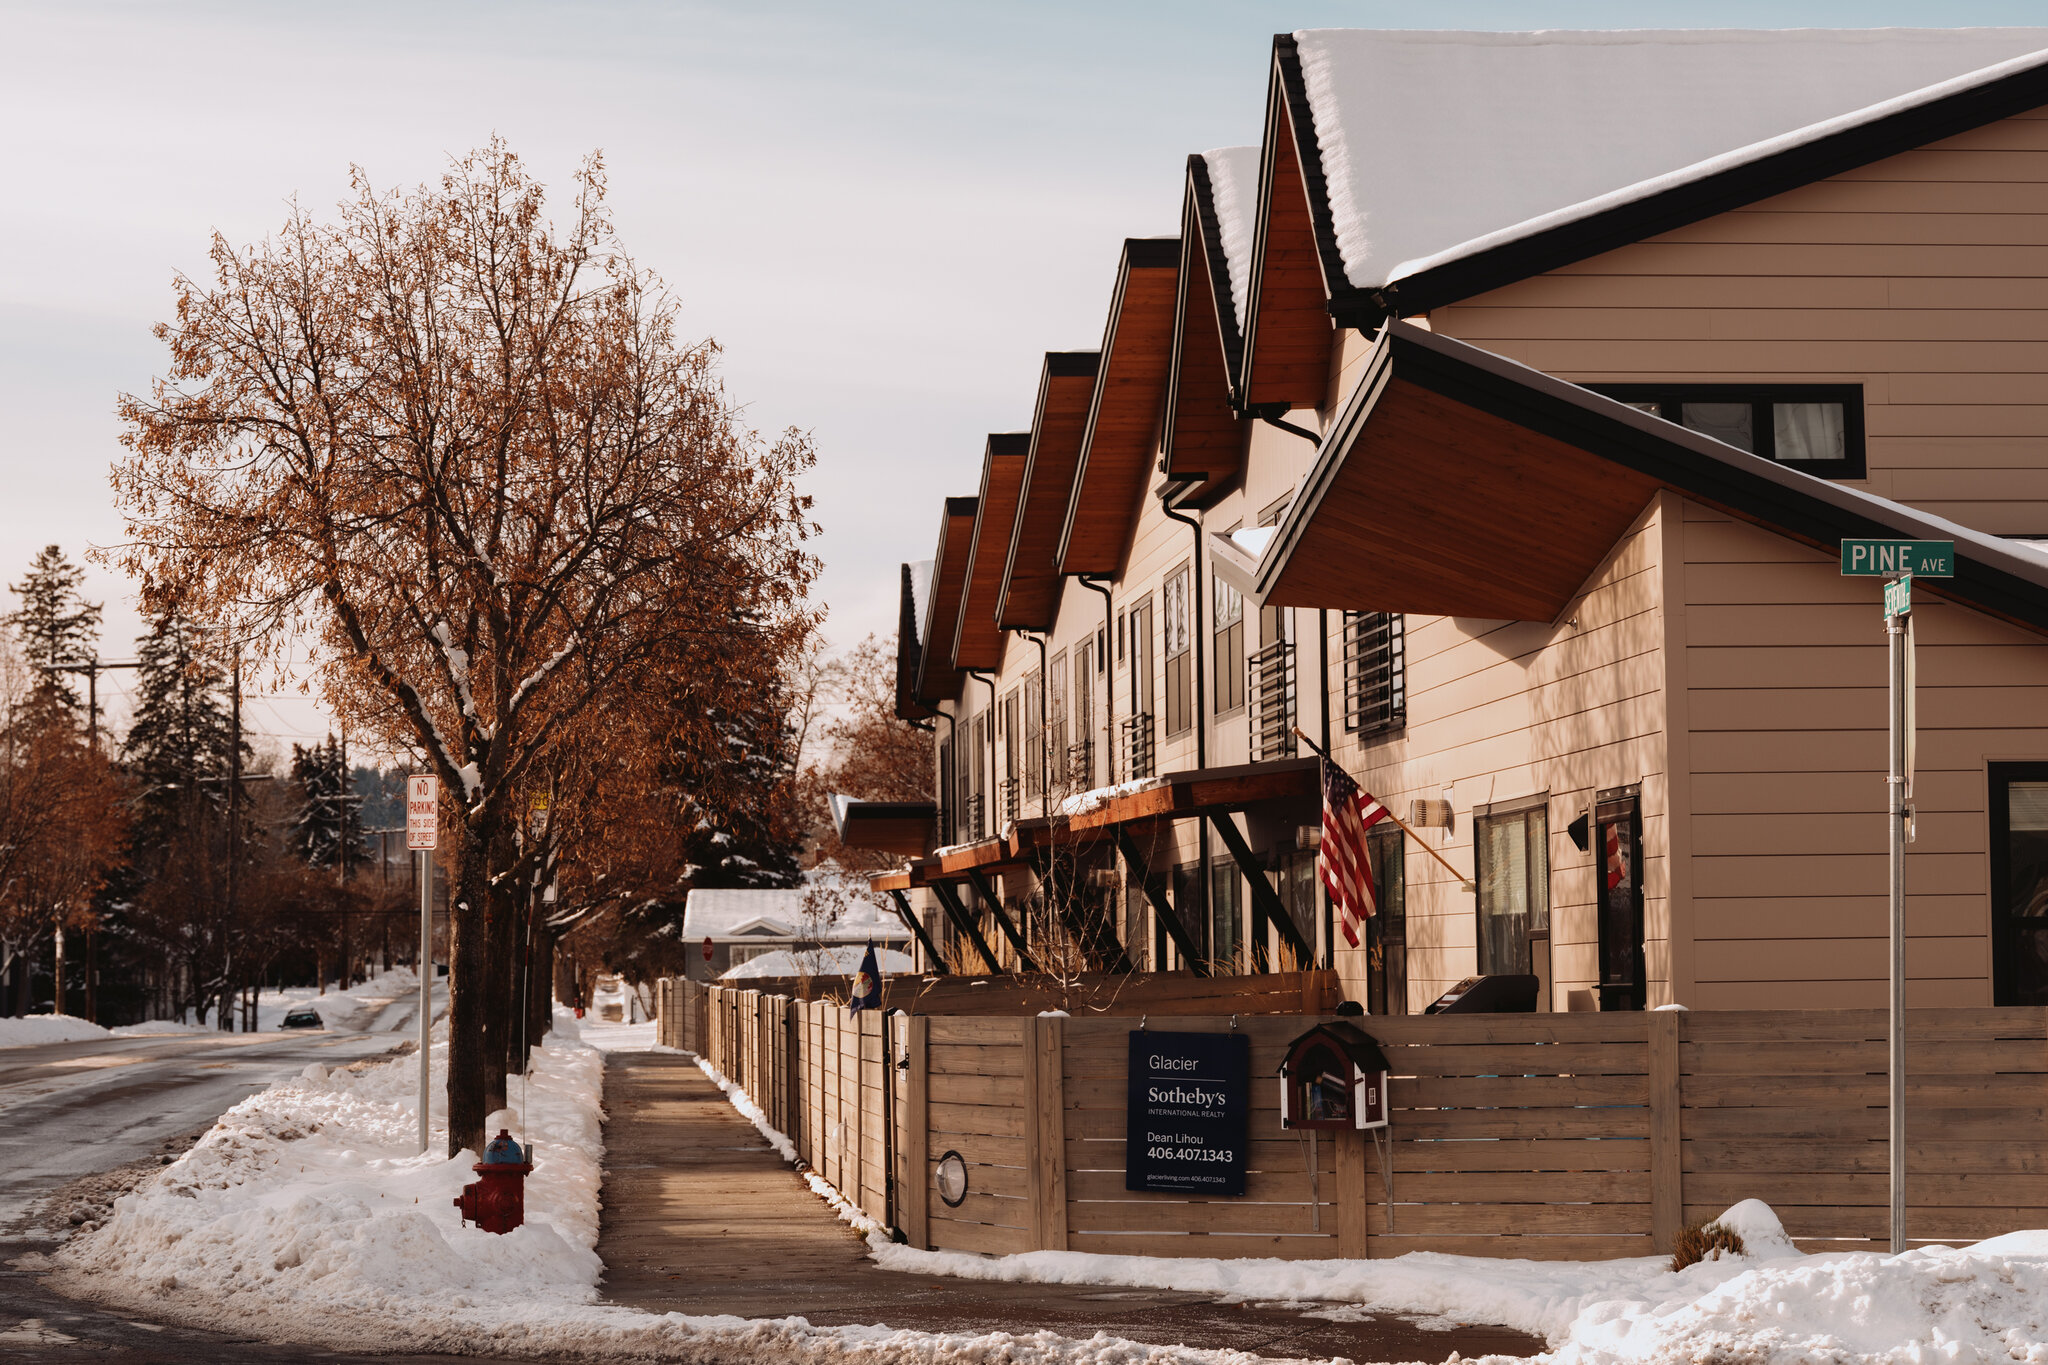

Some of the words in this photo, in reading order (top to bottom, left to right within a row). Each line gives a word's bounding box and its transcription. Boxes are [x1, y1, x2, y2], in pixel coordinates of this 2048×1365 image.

[1852, 545, 1913, 571] PINE
[1920, 558, 1946, 572] AVE
[417, 782, 428, 795] NO
[410, 801, 434, 814] PARKING
[410, 819, 420, 828] THIS
[424, 819, 434, 828] SIDE
[409, 832, 416, 842] OF
[417, 832, 434, 842] STREET
[1149, 1054, 1199, 1071] Glacier
[1148, 1086, 1226, 1109] Sotheby's
[1148, 1109, 1200, 1117] INTERNATIONAL
[1201, 1110, 1225, 1118] REALTY
[1147, 1132, 1173, 1143] Dean
[1175, 1133, 1204, 1145] Lihou
[1147, 1147, 1233, 1163] 406.407.1343
